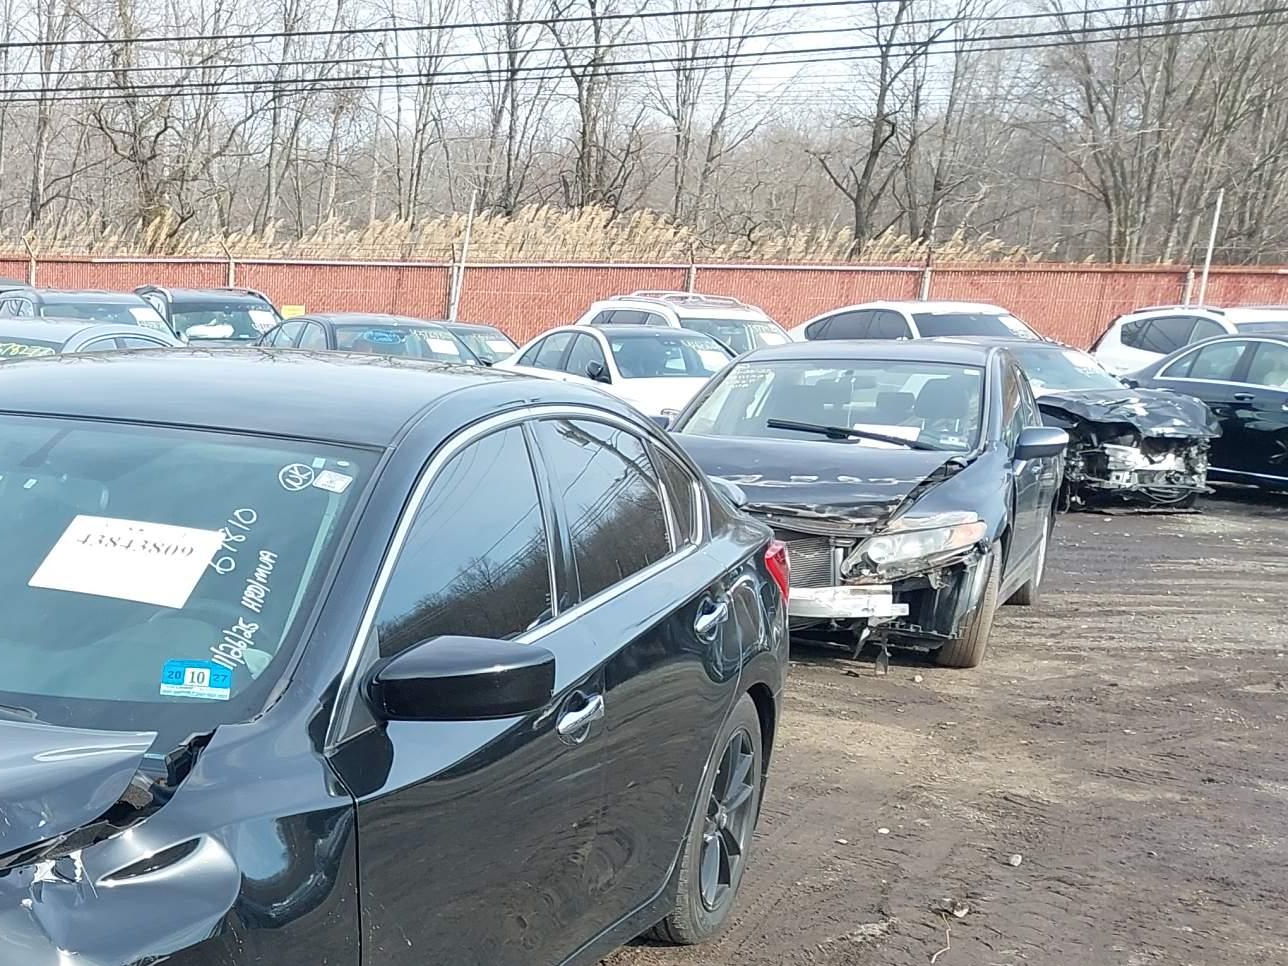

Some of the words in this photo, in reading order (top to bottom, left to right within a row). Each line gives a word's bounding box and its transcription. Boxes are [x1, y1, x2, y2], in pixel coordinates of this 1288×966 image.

[167, 670, 182, 680] 20
[188, 670, 206, 685] 10
[213, 673, 228, 683] 27
